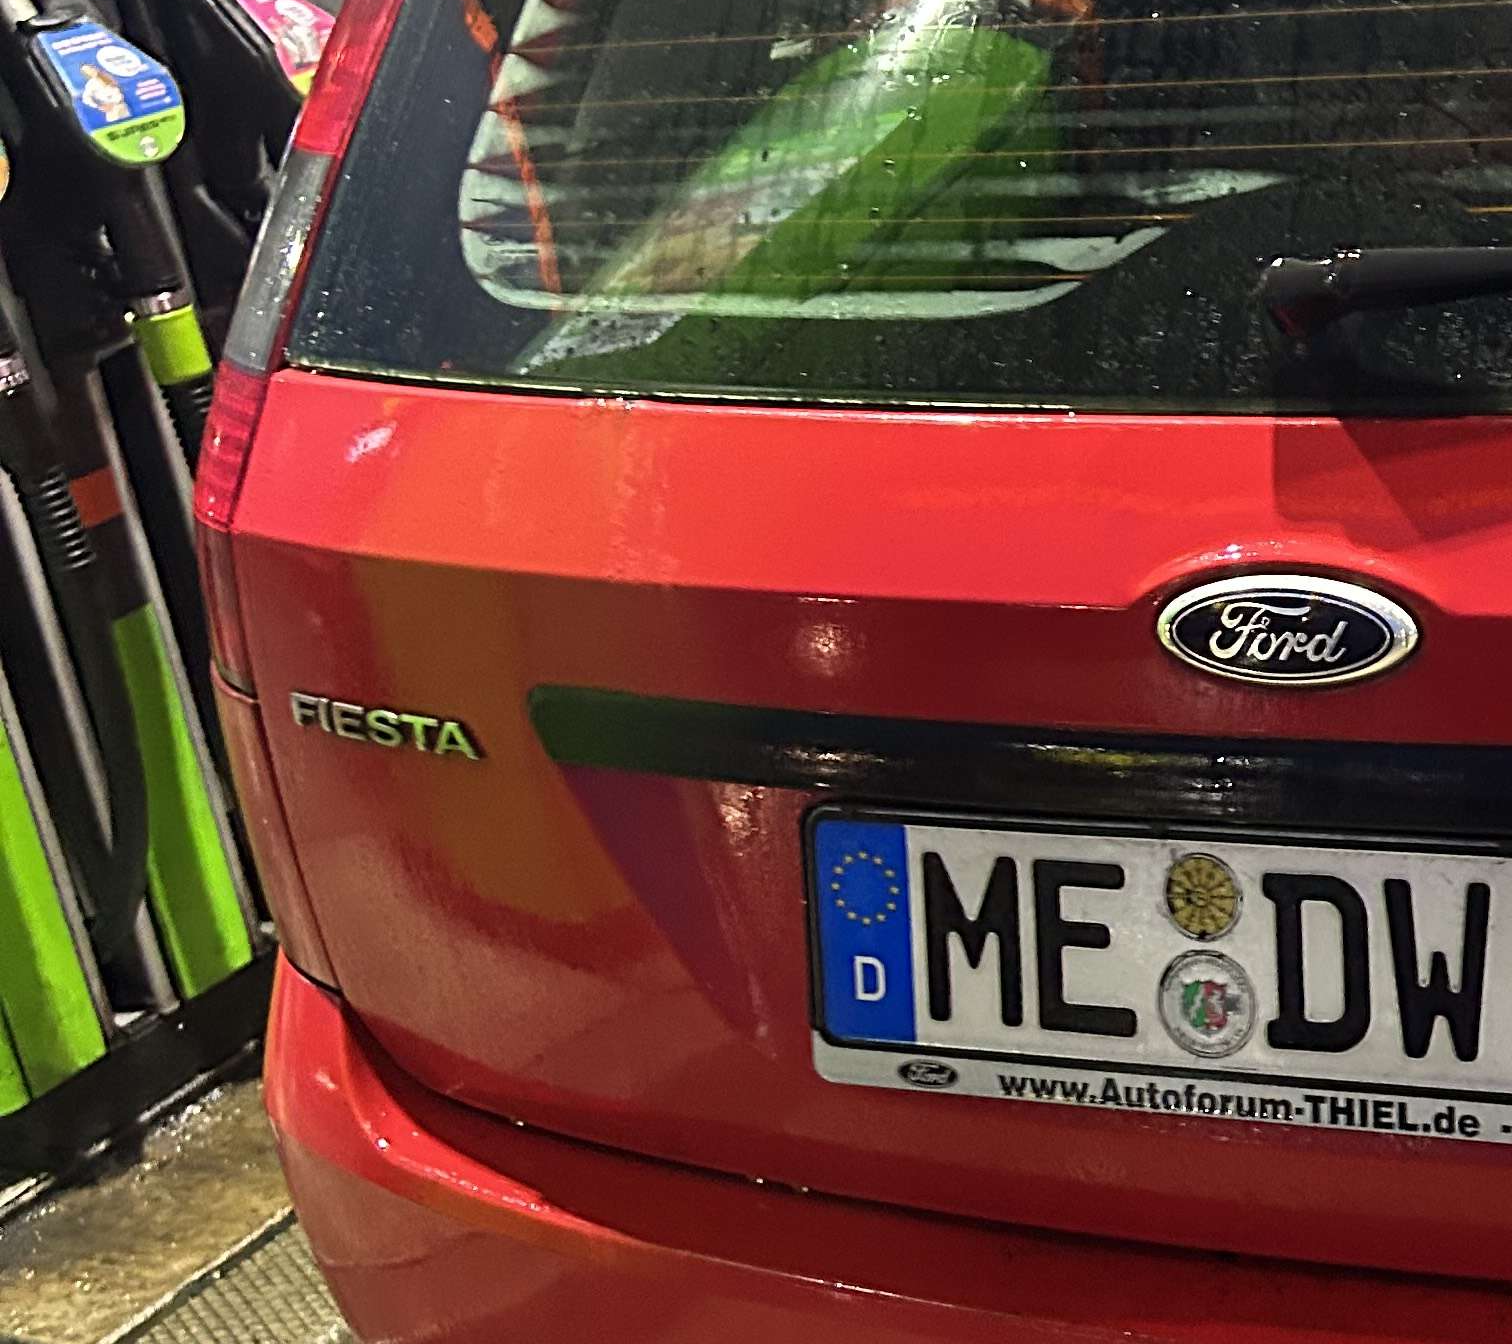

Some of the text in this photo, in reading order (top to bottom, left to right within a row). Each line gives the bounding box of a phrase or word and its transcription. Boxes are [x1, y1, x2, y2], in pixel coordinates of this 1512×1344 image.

[1208, 601, 1348, 663] Ford
[290, 691, 480, 760] FIESTA
[853, 955, 887, 1002] D
[922, 851, 1138, 1038] ME
[1261, 870, 1491, 1063] DW
